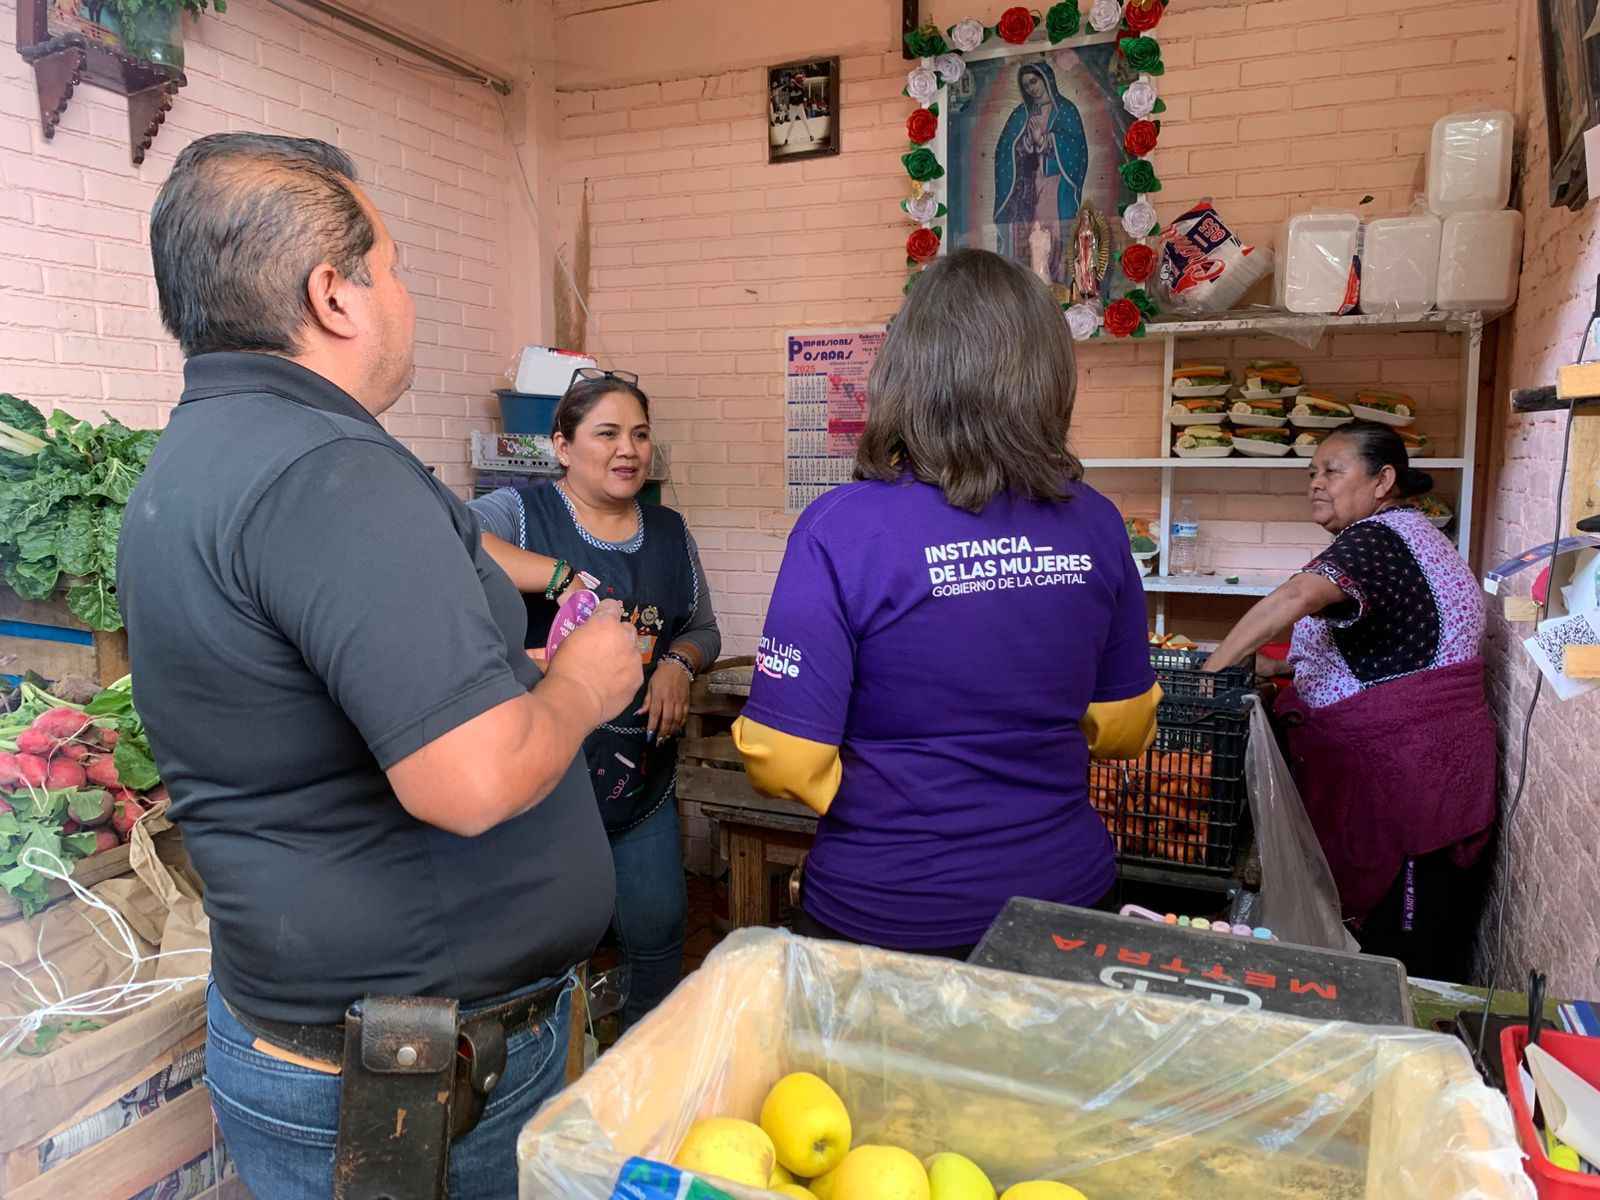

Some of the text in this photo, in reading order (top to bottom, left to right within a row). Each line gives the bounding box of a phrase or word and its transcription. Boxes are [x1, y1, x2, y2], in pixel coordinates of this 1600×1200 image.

[1198, 218, 1226, 242] 855
[795, 365, 816, 373] 2025
[929, 554, 1093, 585] DE LAS MUJERES
[932, 573, 1086, 597] GOBIERNO DE LA CAPITAL
[760, 636, 802, 661] an Luis
[1051, 934, 1337, 1000] METTRIA
